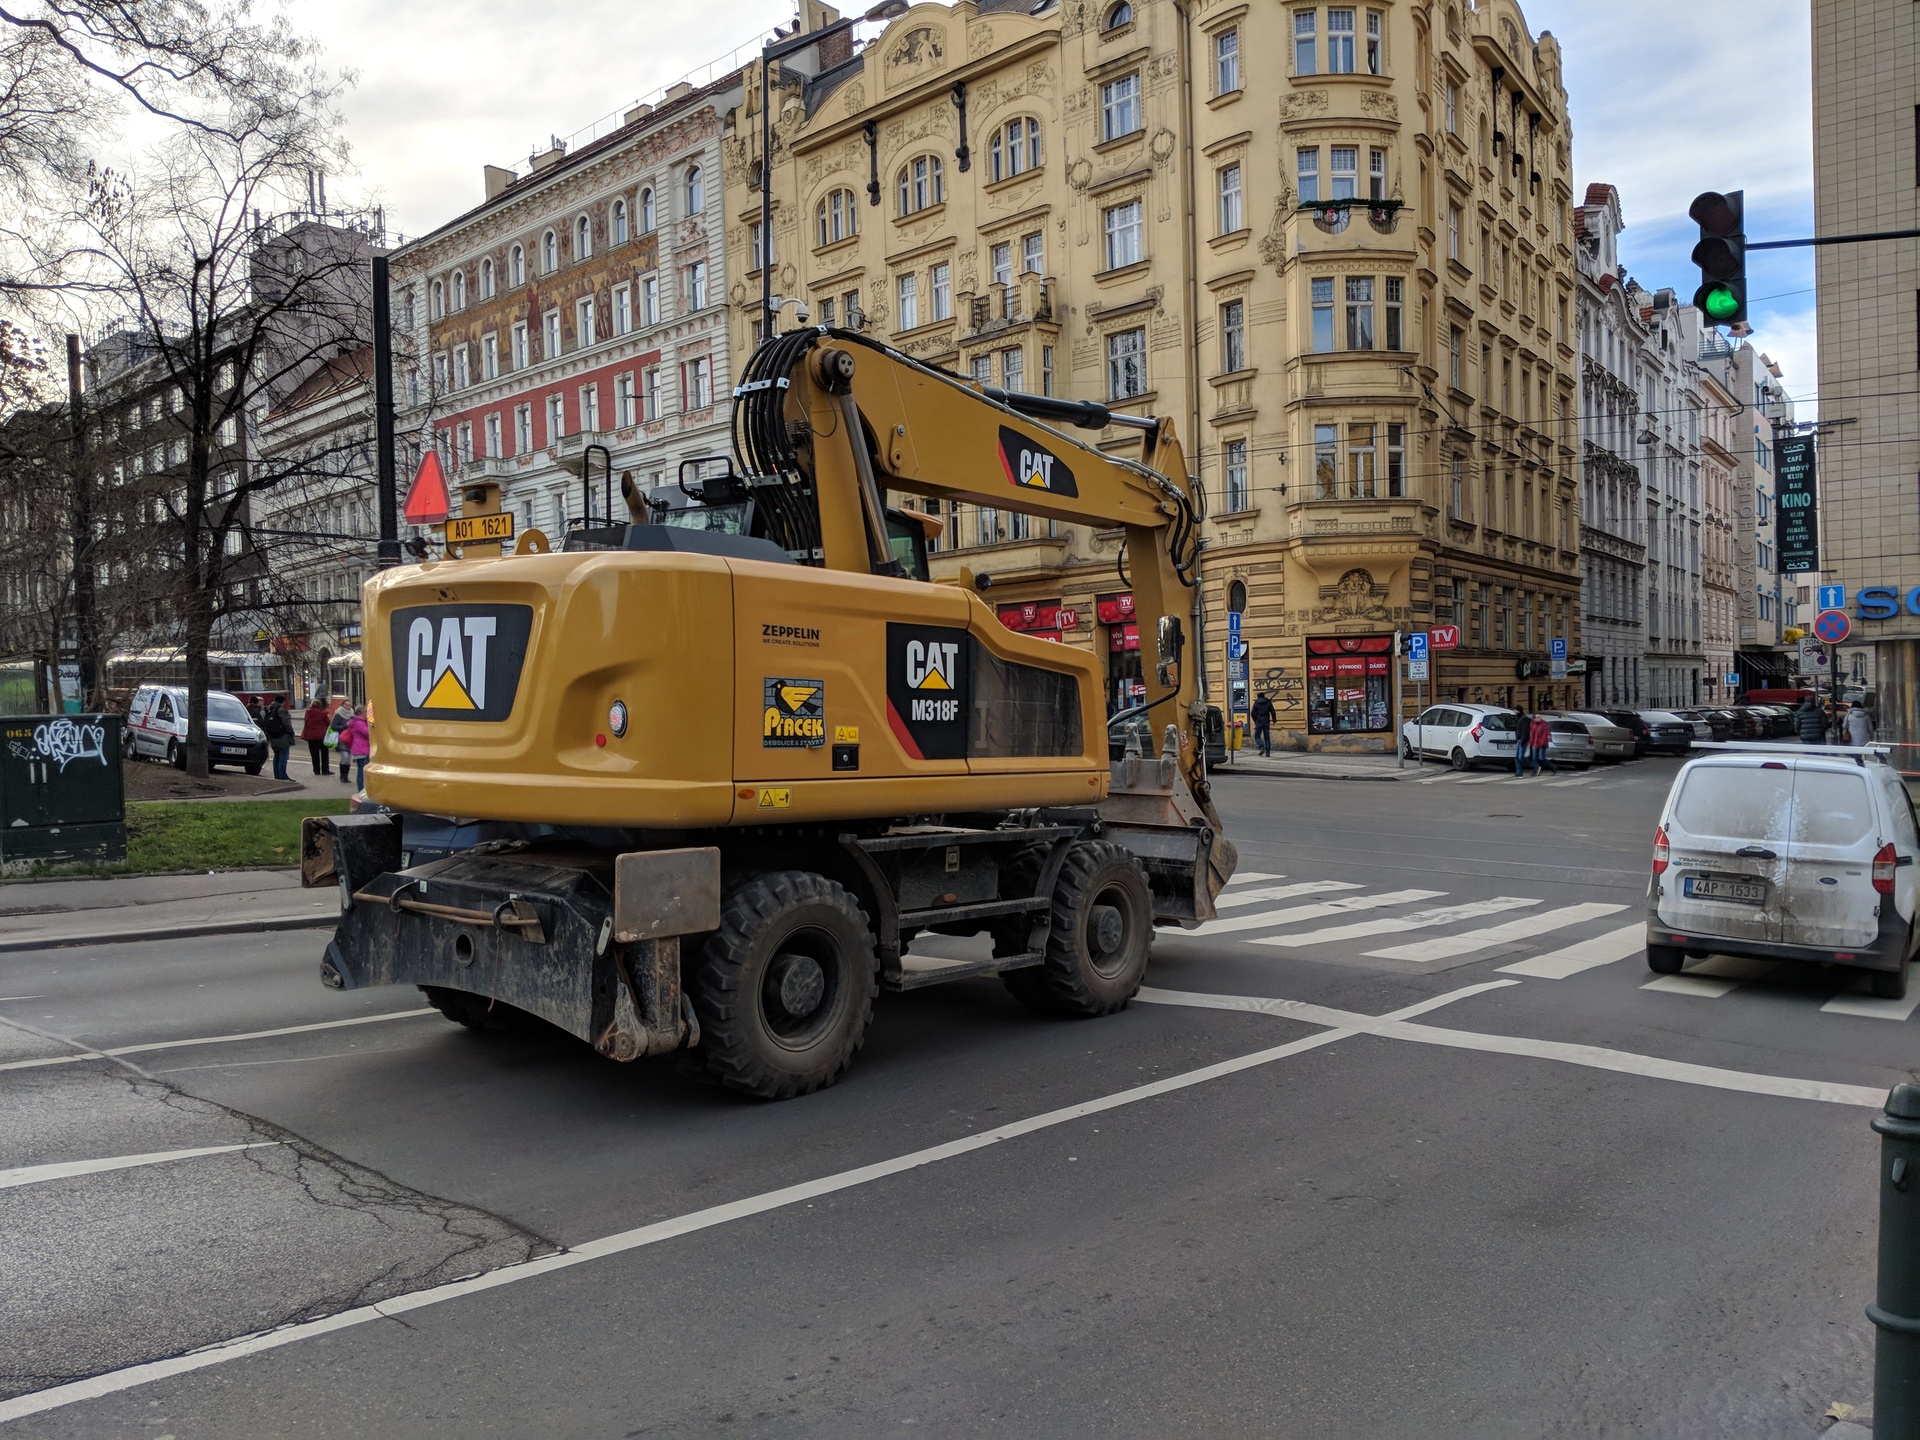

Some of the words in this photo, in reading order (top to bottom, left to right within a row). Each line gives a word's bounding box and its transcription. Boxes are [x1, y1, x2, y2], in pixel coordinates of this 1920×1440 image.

[1787, 454, 1802, 463] CAFÉ
[1020, 449, 1053, 489] CAT
[1781, 463, 1809, 473] FILMOVÝ
[1739, 471, 1753, 532] HOUSE
[1782, 492, 1811, 508] KINO
[455, 520, 474, 539] A01
[482, 516, 507, 536] 1621
[1740, 543, 1755, 618] MOSAIC
[1122, 598, 1132, 607] TV
[1024, 608, 1034, 616] TV
[1062, 610, 1075, 625] TV
[762, 624, 820, 640] ZEPPELIN
[1431, 629, 1454, 643] TV
[1231, 635, 1239, 651] P
[1412, 637, 1424, 652] P
[1553, 641, 1563, 653] P
[1804, 638, 1821, 646] ZÓN
[407, 616, 497, 710] CAT
[906, 640, 958, 690] CAT
[911, 699, 959, 721] M318F
[6, 729, 32, 738] 065
[1695, 881, 1719, 894] 4AP
[1728, 884, 1759, 898] 1533
